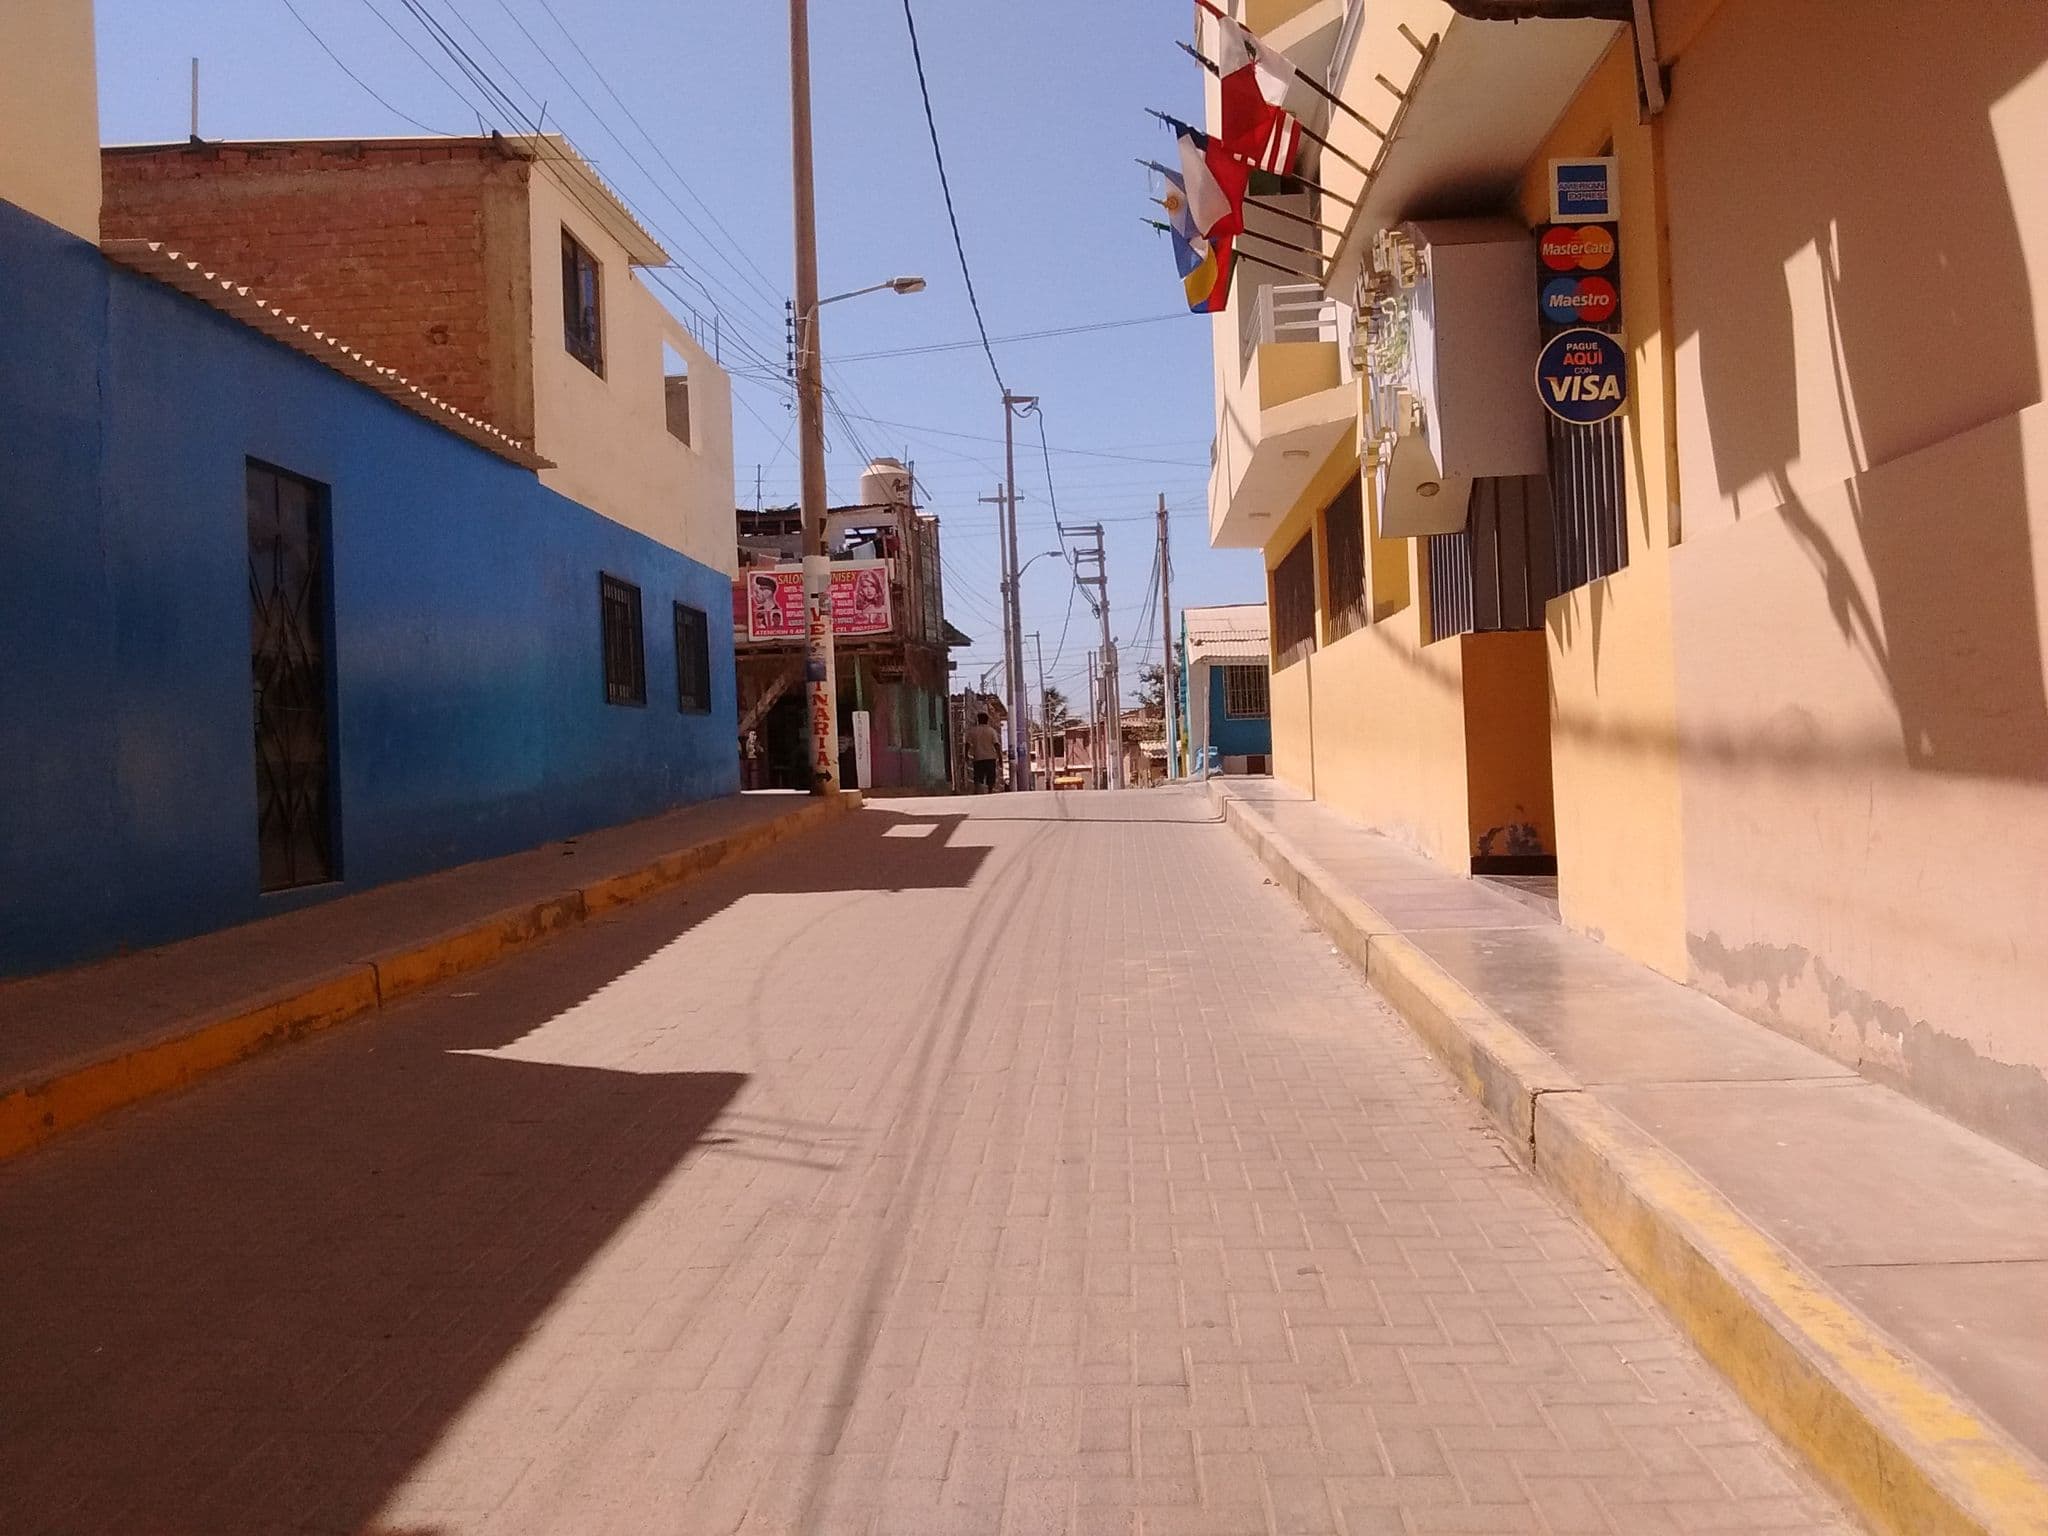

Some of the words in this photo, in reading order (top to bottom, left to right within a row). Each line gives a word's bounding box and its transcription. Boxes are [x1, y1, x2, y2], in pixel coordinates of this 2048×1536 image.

[1558, 181, 1606, 191] AMERICAN
[1542, 241, 1612, 256] MasterCard
[1549, 292, 1610, 308] Maestro
[1566, 342, 1599, 351] PAGUE
[1574, 366, 1592, 375] CON
[1544, 375, 1621, 403] VISA
[832, 572, 857, 584] NISEX
[810, 607, 831, 767] VEINARIA
